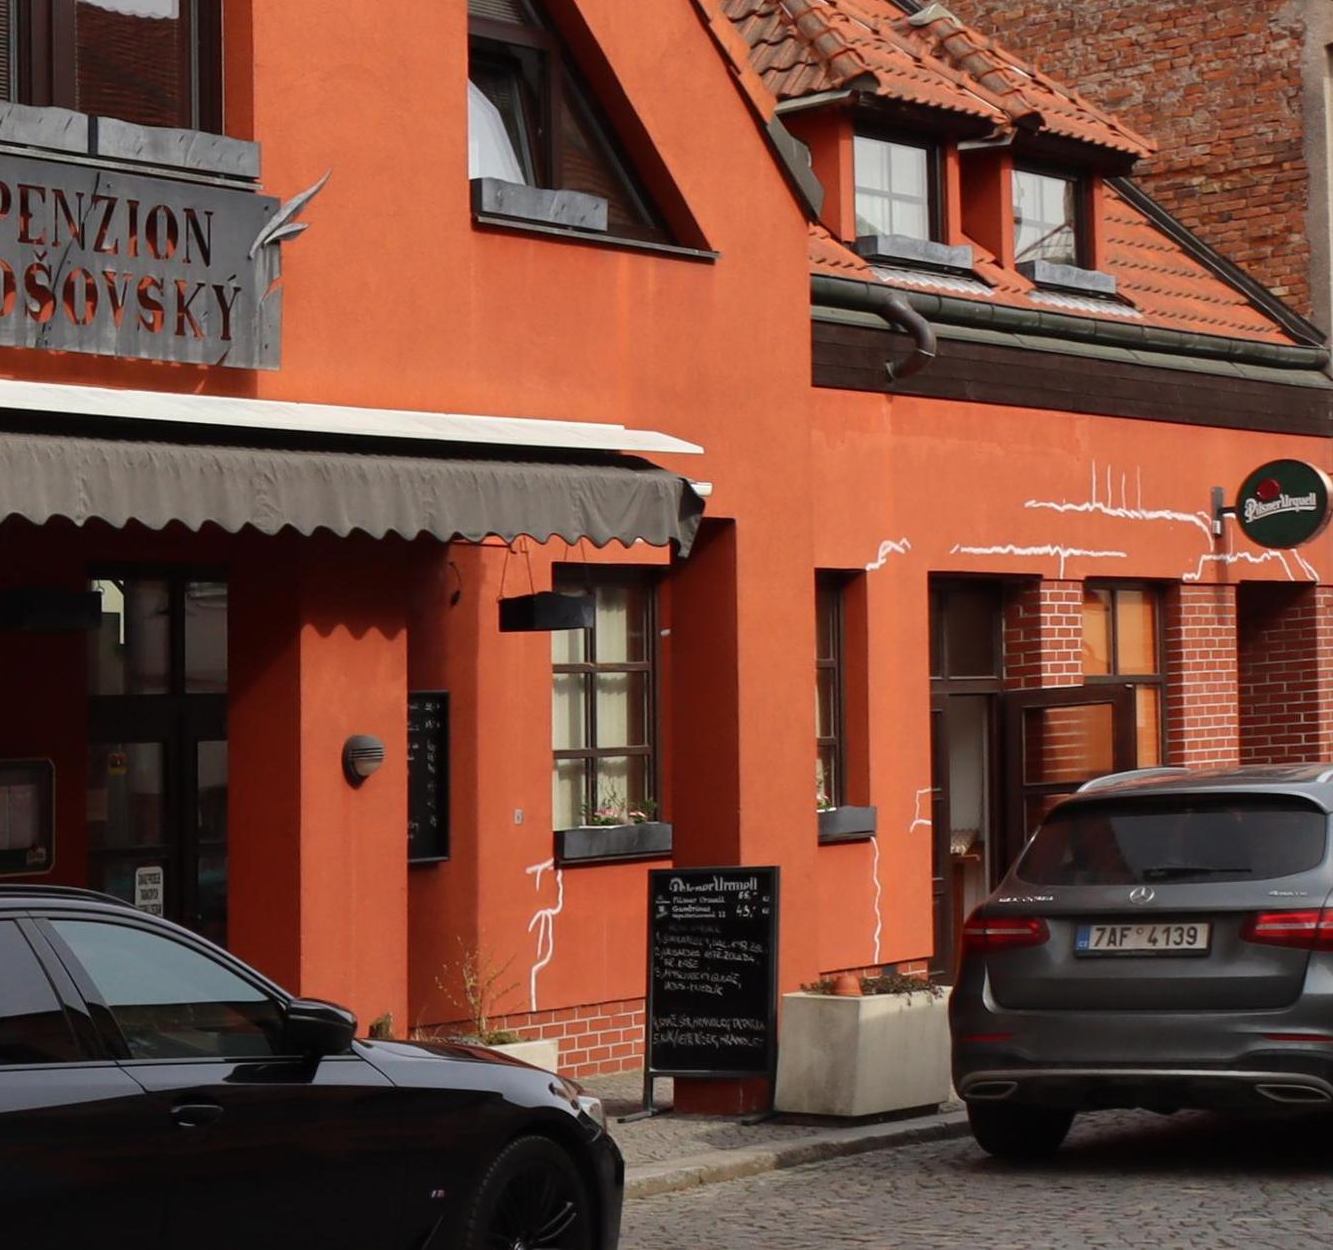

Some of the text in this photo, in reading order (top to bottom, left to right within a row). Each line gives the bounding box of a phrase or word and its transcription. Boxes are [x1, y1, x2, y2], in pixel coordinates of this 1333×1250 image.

[1244, 492, 1317, 524] Pilsner Urquell
[1092, 926, 1129, 947] 7AF
[1148, 924, 1198, 947] 4139
